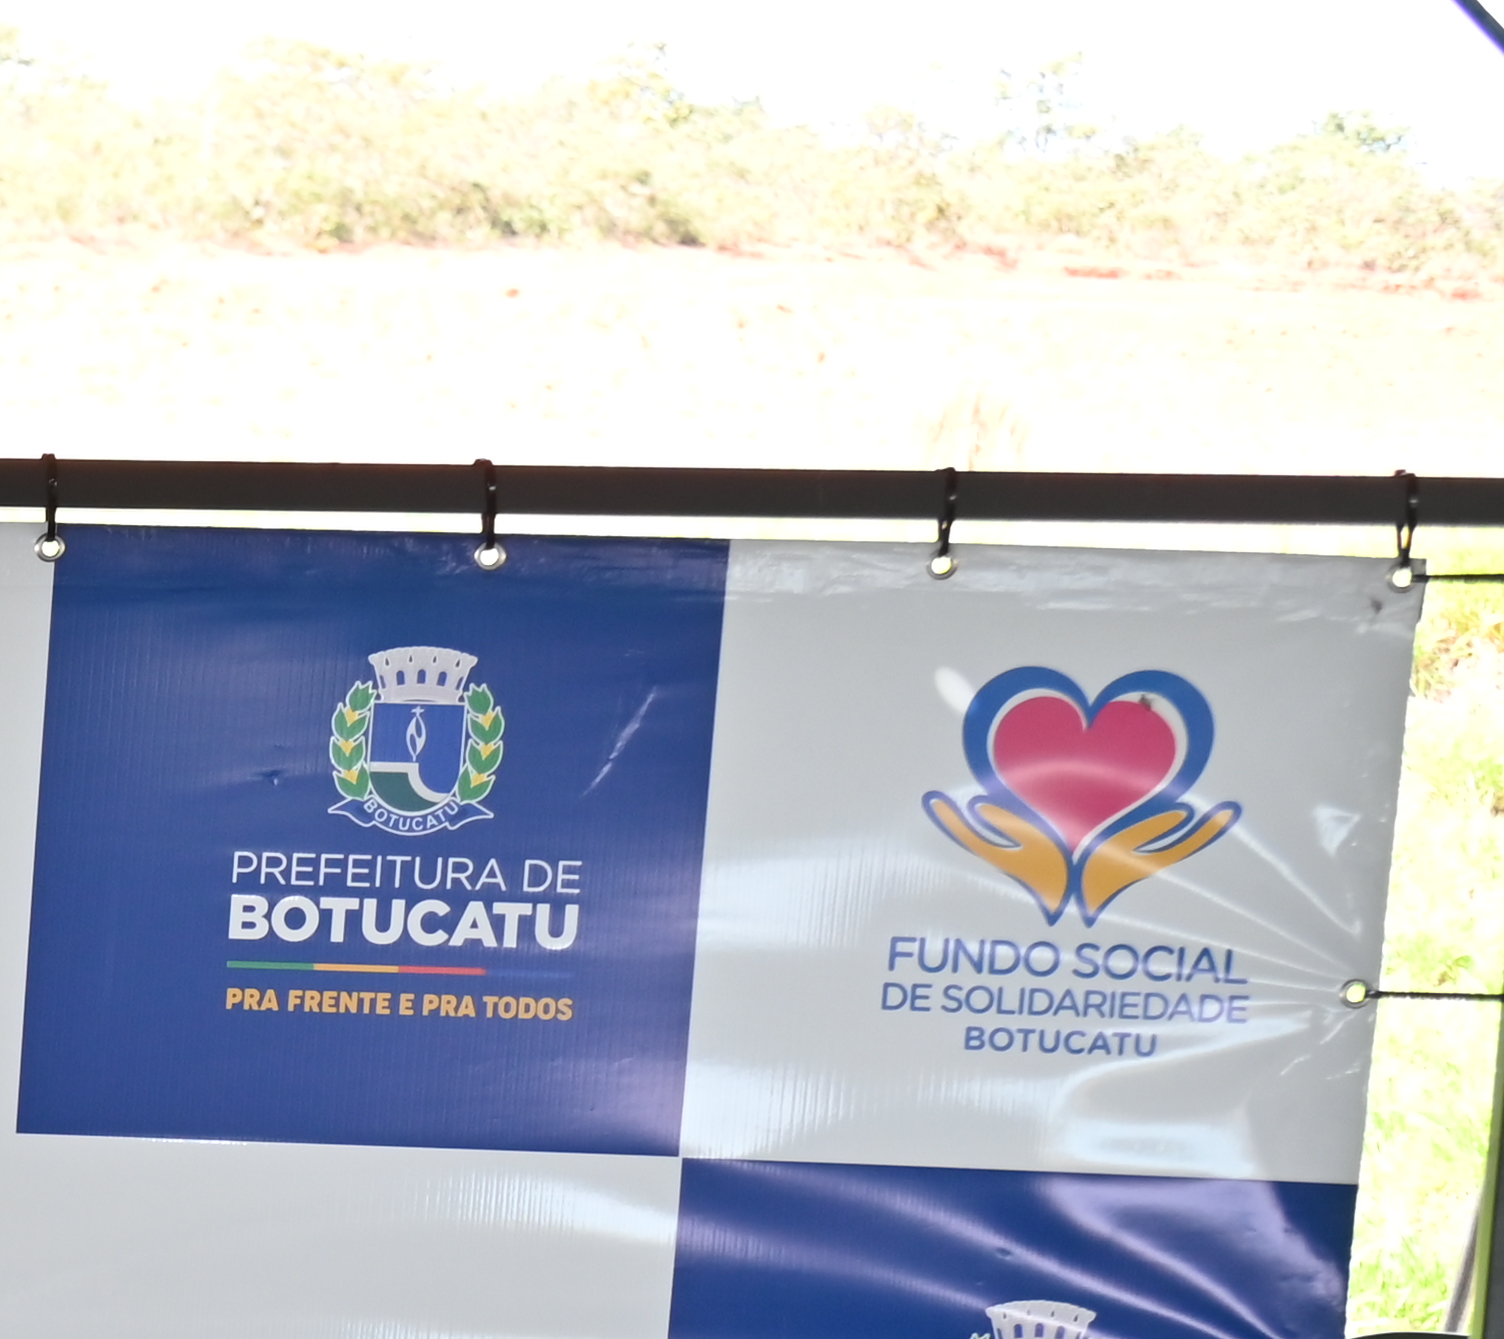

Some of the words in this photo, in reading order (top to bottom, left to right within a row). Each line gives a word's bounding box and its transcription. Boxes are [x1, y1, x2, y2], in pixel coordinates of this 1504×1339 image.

[362, 798, 460, 832] BOTUCATU
[231, 850, 507, 892] PREFEITURA
[522, 858, 583, 895] DE
[228, 893, 580, 951] BOTUCATU
[887, 935, 1062, 978] FUNDO
[1071, 942, 1250, 986] SOCIAL
[225, 986, 280, 1012] PRA
[287, 988, 392, 1017] FRENTE
[398, 992, 415, 1017] E
[422, 993, 477, 1019] PRA
[482, 995, 574, 1022] TODOS
[880, 981, 934, 1013] DE
[939, 984, 1251, 1025] SOLIDARIEDADE
[963, 1025, 1158, 1059] BOTUCATU
